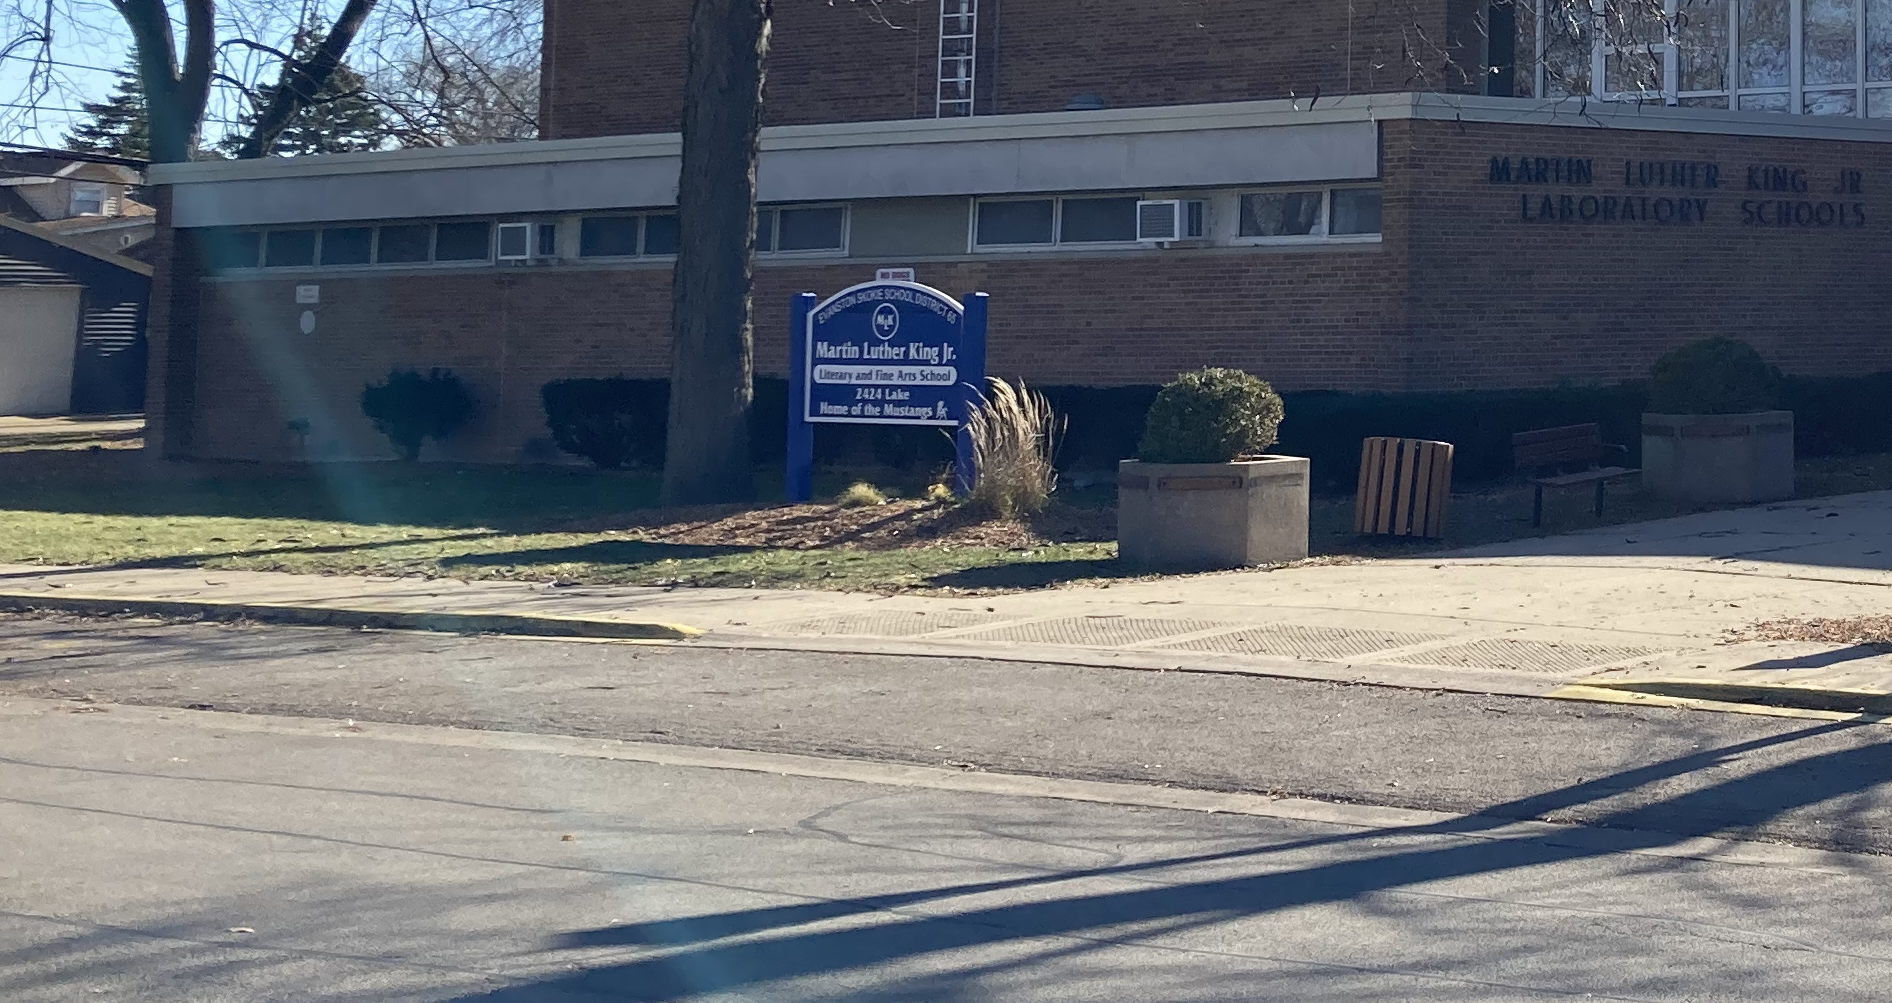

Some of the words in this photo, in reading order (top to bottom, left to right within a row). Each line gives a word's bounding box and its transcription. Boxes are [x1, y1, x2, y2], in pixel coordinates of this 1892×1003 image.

[1489, 156, 1593, 184] MARTIN
[1625, 159, 1719, 189] LUTHER
[1746, 165, 1808, 193] KING
[1834, 169, 1863, 195] JR
[1521, 193, 1708, 222] LABORATORY
[1741, 199, 1866, 227] SCHOOLS
[884, 288, 915, 302] SCHOOL
[915, 294, 947, 319] DISTRICT
[816, 341, 859, 359] Martin
[863, 341, 906, 360] Luther
[909, 342, 939, 364] King
[942, 343, 957, 364] Jr.
[819, 369, 852, 383] Literary
[855, 370, 872, 380] and
[876, 370, 894, 381] Fine
[897, 370, 916, 381] Arts
[920, 371, 950, 382] School
[856, 388, 882, 399] 2424
[885, 389, 910, 400] Lake
[820, 402, 848, 415] Home
[851, 403, 862, 415] of
[864, 404, 881, 415] the
[883, 404, 932, 419] Mustangs
